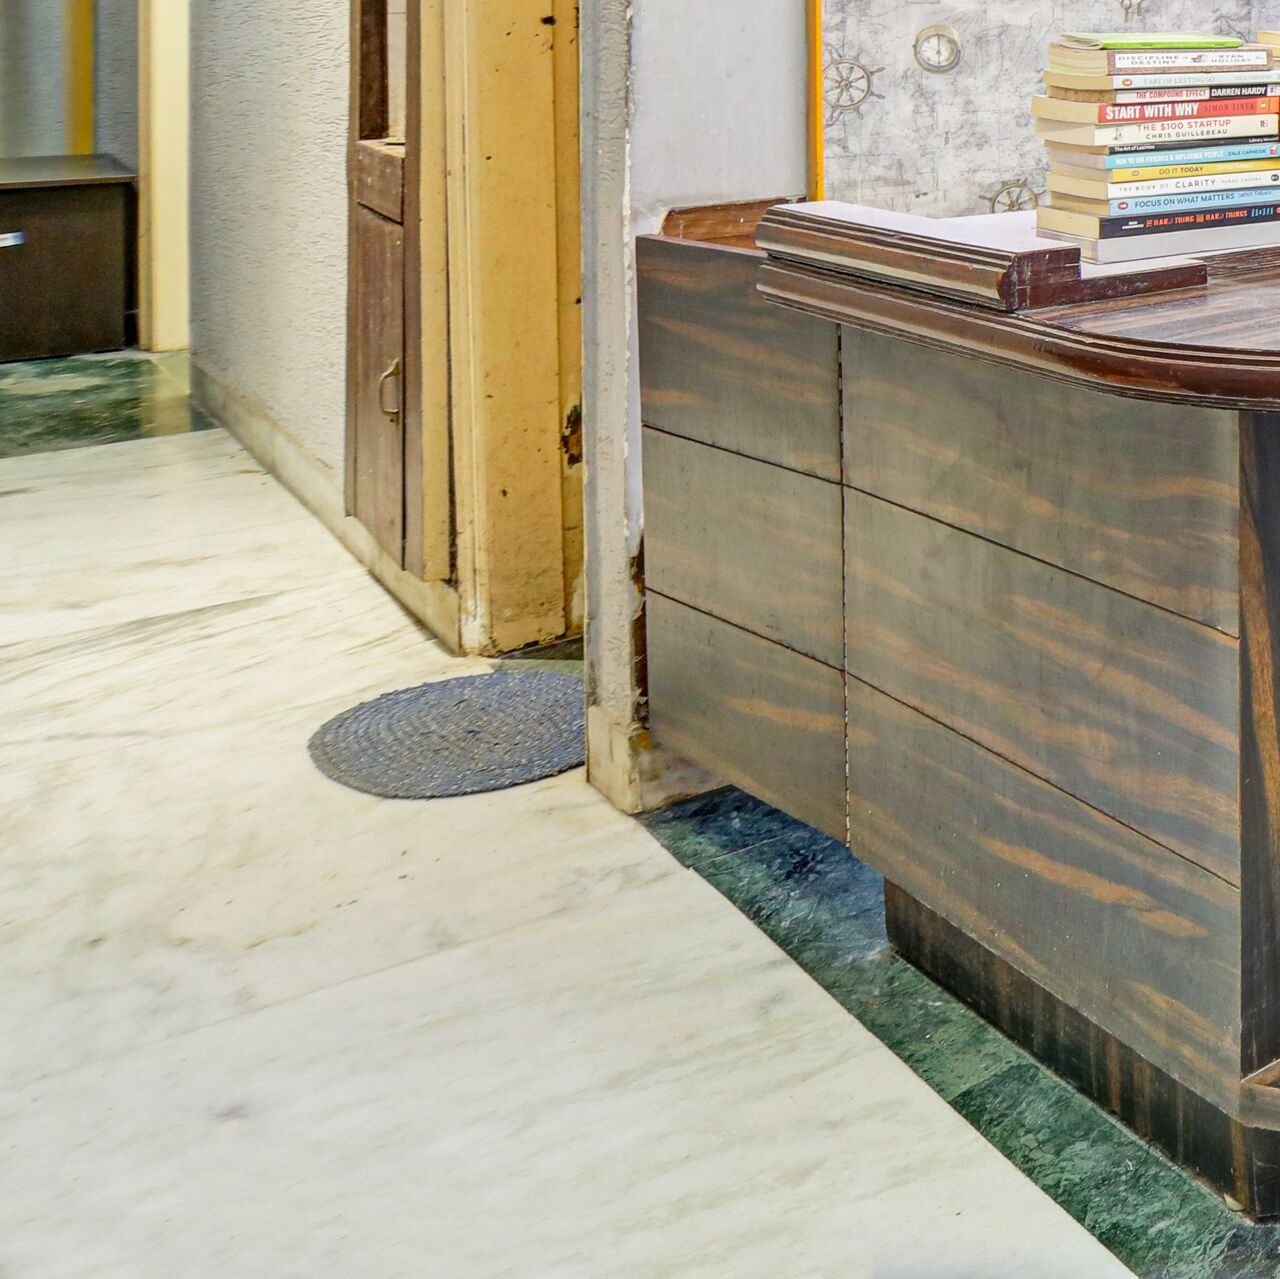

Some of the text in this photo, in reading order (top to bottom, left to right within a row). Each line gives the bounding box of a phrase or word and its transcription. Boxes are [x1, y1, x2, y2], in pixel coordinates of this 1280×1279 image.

[1136, 88, 1206, 99] THE COMPOUND EFFECT
[1211, 86, 1266, 97] DARREN HARDY
[1106, 102, 1199, 120] START WITH WHY
[1204, 102, 1254, 112] SIMON SINEK
[1136, 120, 1231, 131] THE $100 STARTUP
[1146, 129, 1228, 140] CHRIS GUILLEBEAU
[1175, 179, 1215, 188] CLARITY
[1135, 200, 1161, 208] FOCUS
[1200, 193, 1235, 201] MATTERS
[1175, 215, 1194, 223] THING
[1226, 210, 1248, 218] THINGS
